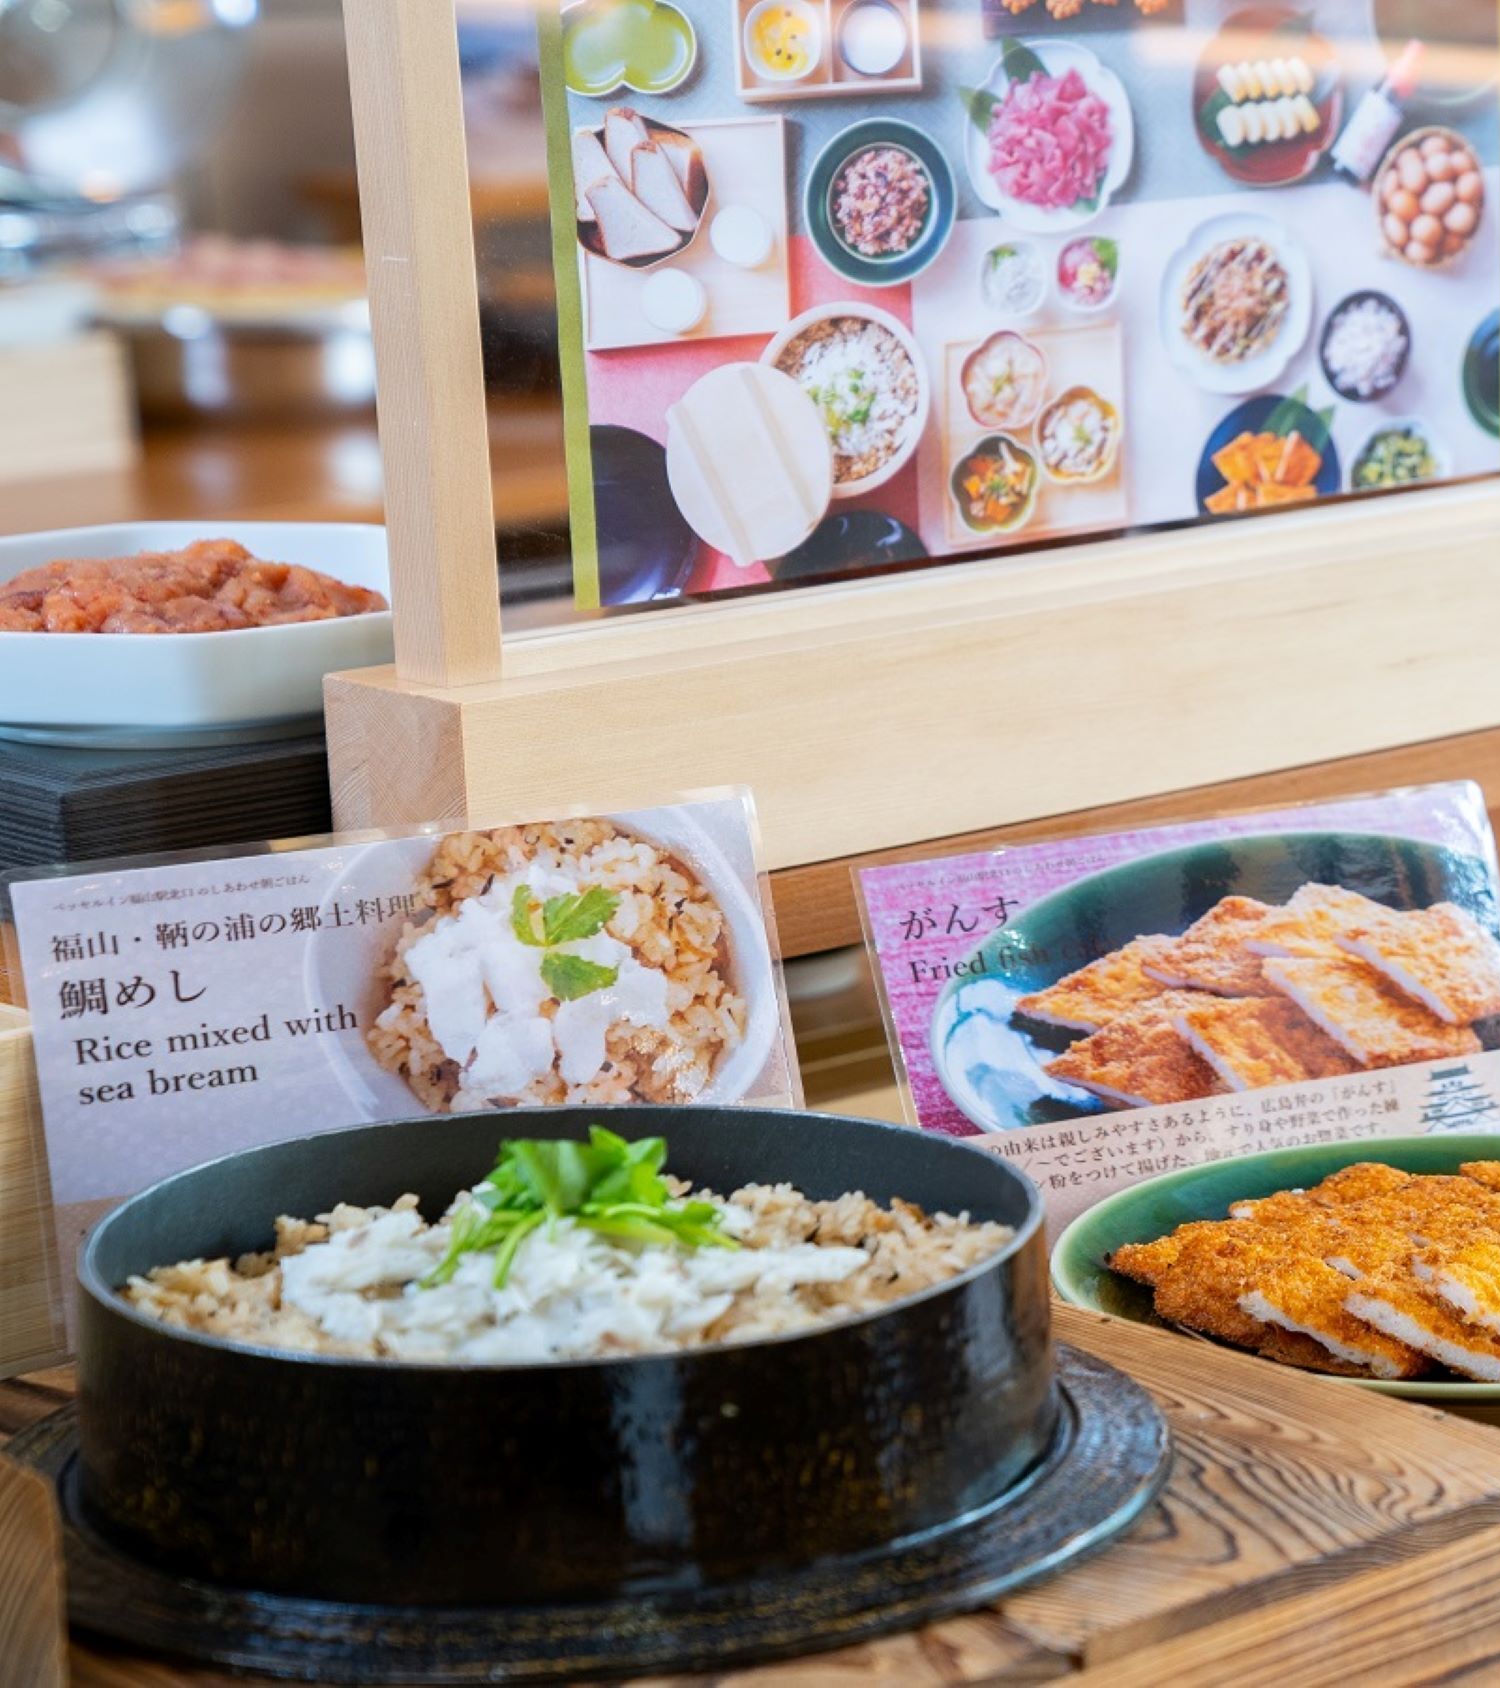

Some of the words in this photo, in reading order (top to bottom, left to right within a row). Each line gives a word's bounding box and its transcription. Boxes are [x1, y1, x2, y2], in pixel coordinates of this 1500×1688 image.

[52, 893, 417, 963] 福山・鞆の浦の郷土料理
[899, 896, 1019, 941] がんす
[909, 951, 987, 983] Fried
[59, 969, 207, 1019] 鯛めし
[75, 1035, 152, 1065] Rice
[167, 1014, 271, 1053] mixed
[284, 1004, 358, 1037] with
[79, 1080, 135, 1105] sea
[147, 1064, 258, 1096] bream
